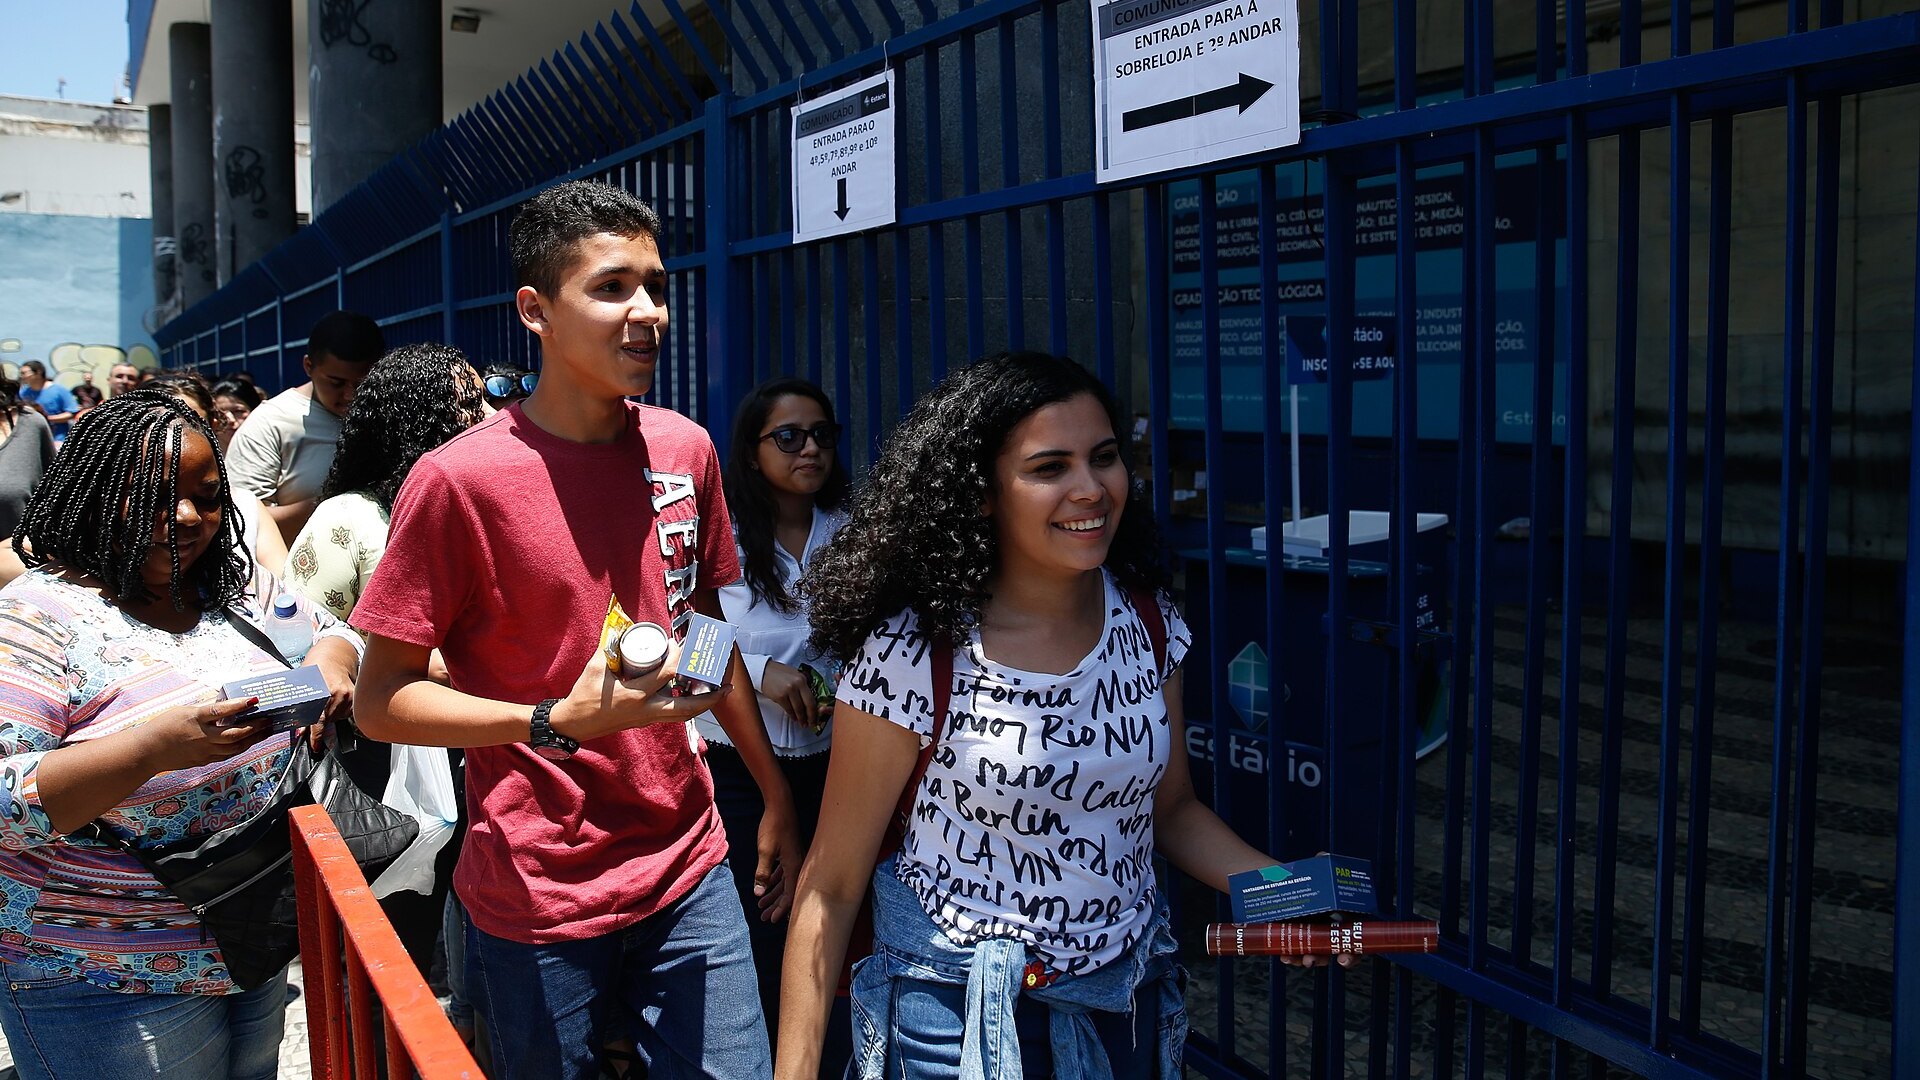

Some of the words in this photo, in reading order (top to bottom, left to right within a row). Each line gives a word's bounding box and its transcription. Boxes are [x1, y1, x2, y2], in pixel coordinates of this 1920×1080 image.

[1114, 0, 1197, 26] COMUNI
[1134, 19, 1201, 49] ENTRADA
[1204, 4, 1243, 28] PARA
[1115, 46, 1192, 79] SOBRELOJA
[1196, 41, 1204, 56] E
[1228, 17, 1282, 48] ANDAR
[800, 104, 854, 131] COMUNICADO
[813, 129, 847, 149] ENTRADA
[858, 143, 864, 152] e
[865, 136, 878, 150] 10º
[831, 161, 857, 178] ANDAR
[1174, 188, 1239, 210] GRADÇÃO
[1174, 286, 1239, 306] GRADÇÃO
[1241, 283, 1324, 302] TECLÓGICA
[1302, 356, 1373, 372] INSC-SE
[1374, 356, 1395, 369] AQU
[1503, 410, 1566, 426] Estio
[687, 651, 701, 673] PAR
[1091, 665, 1160, 720] Mexic
[947, 710, 1028, 756] Lond
[1041, 714, 1096, 751] Rio
[1104, 714, 1153, 763] NY
[1185, 726, 1321, 788] Estáio
[976, 757, 1080, 801] Paris
[1082, 764, 1162, 814] Calif
[952, 779, 1070, 836] Berlin
[957, 828, 996, 873] LA
[1003, 836, 1063, 886] NY
[1058, 834, 1108, 877] Rio
[936, 854, 1004, 906] Paris
[1335, 867, 1351, 878] PAR
[1353, 922, 1363, 940] SEU
